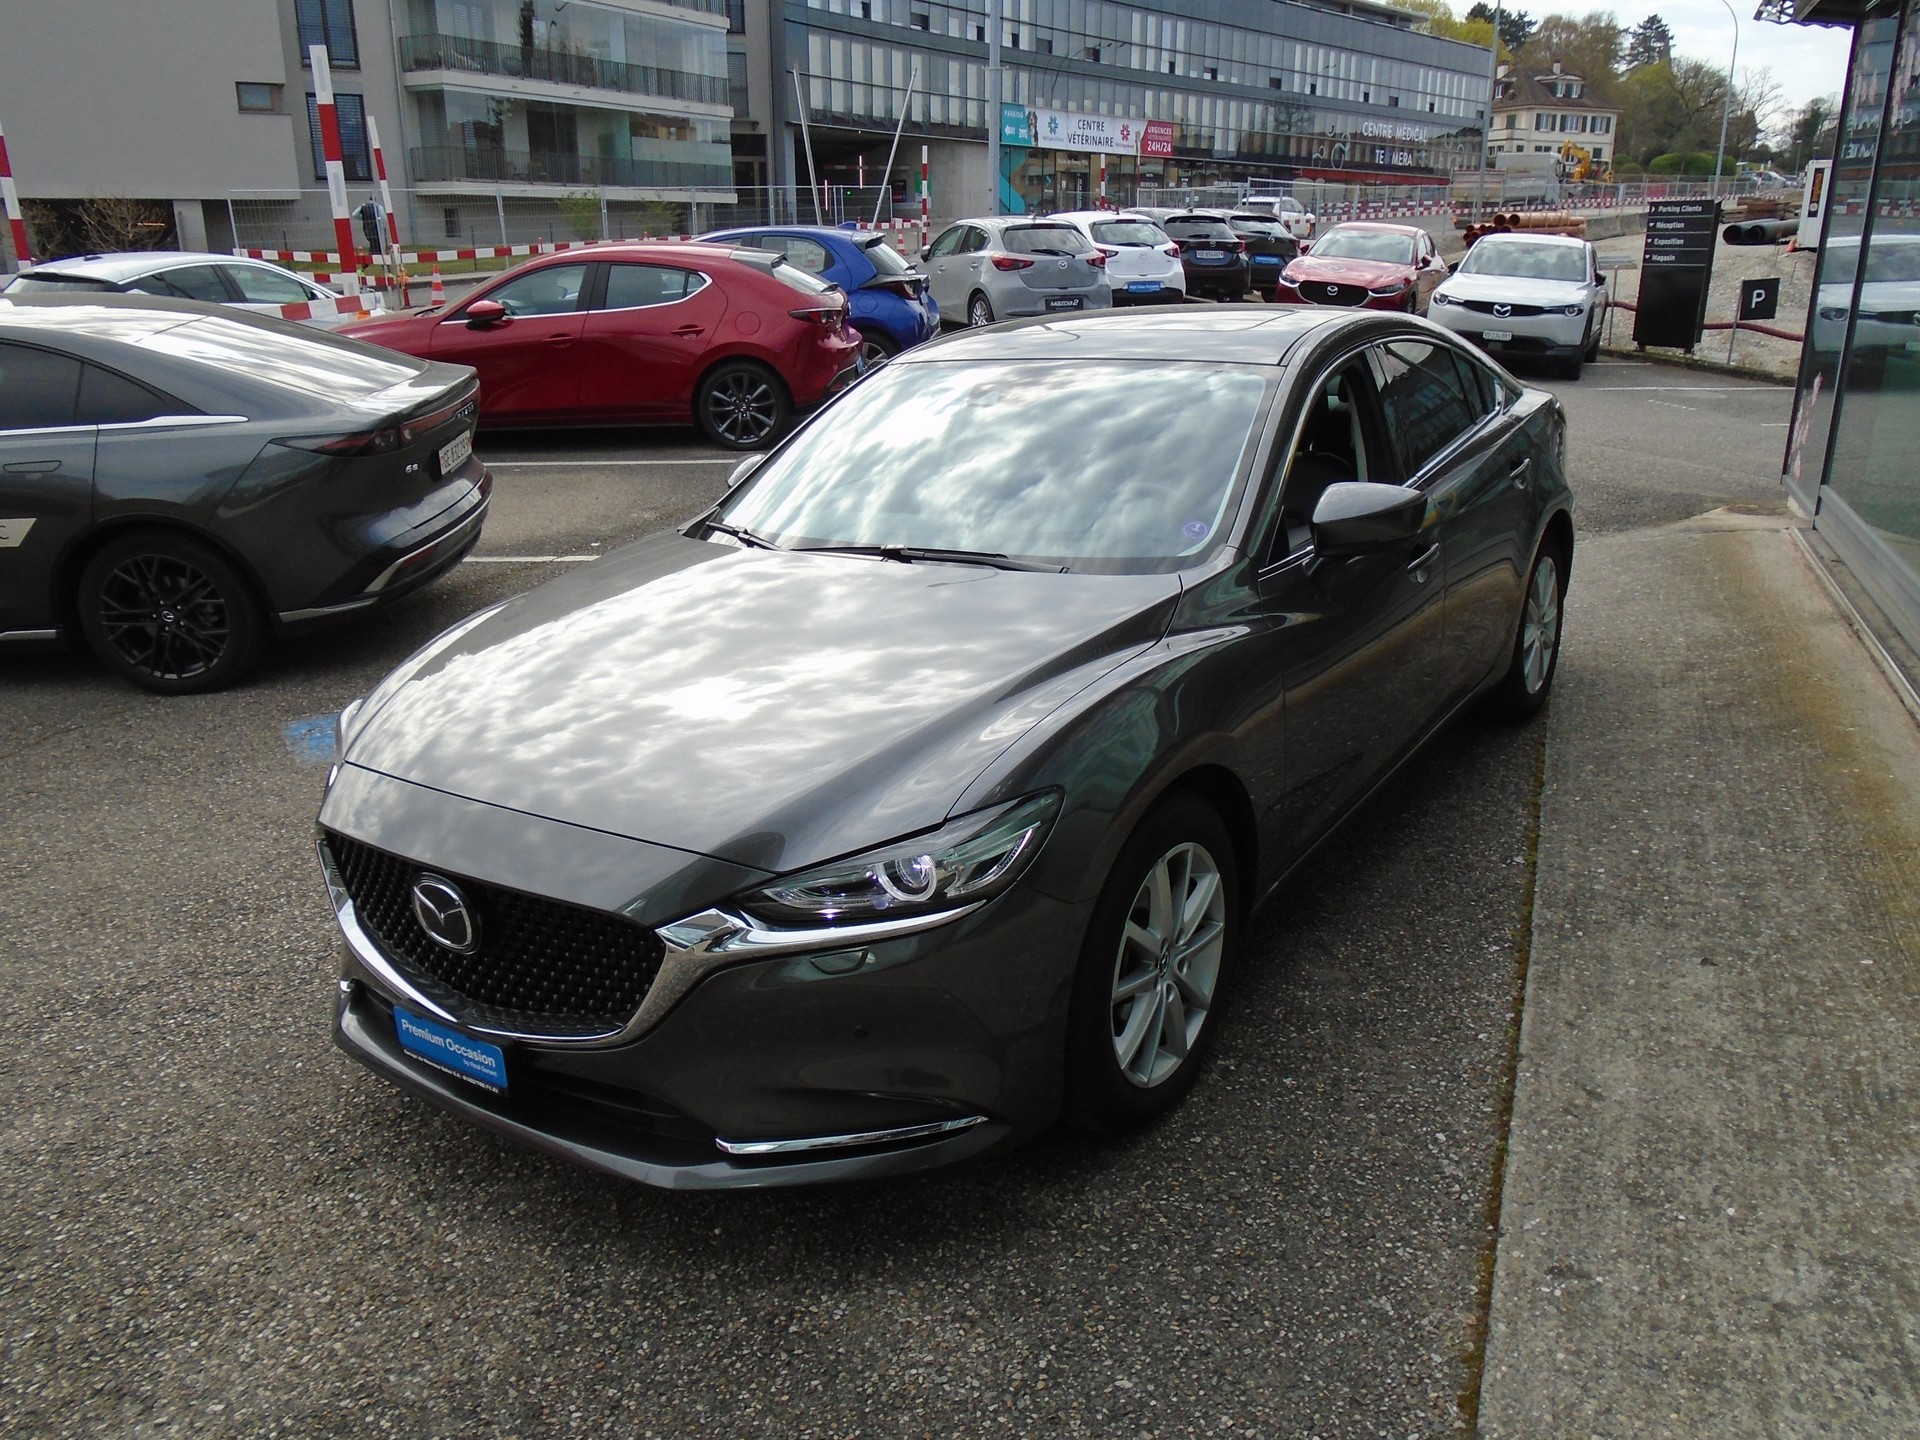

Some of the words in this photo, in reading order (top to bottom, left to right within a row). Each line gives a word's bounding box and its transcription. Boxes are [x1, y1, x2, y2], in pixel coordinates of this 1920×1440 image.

[1077, 118, 1105, 132] CENTRE
[1147, 126, 1172, 136] URGENCES
[1067, 130, 1114, 147] VÉTÉRINAIRE
[1362, 121, 1393, 139] CENTRE
[1395, 124, 1428, 143] MÉDICAL
[1147, 140, 1172, 153] 24H/24
[1391, 151, 1413, 167] MERA
[1658, 205, 1681, 213] Parking
[1681, 204, 1703, 212] Clients
[1656, 220, 1685, 229] Réception
[1653, 237, 1684, 246] Exposition
[1651, 254, 1676, 262] Magasin
[1751, 289, 1766, 309] P
[401, 1018, 445, 1048] Premium
[445, 1038, 496, 1068] Occasion
